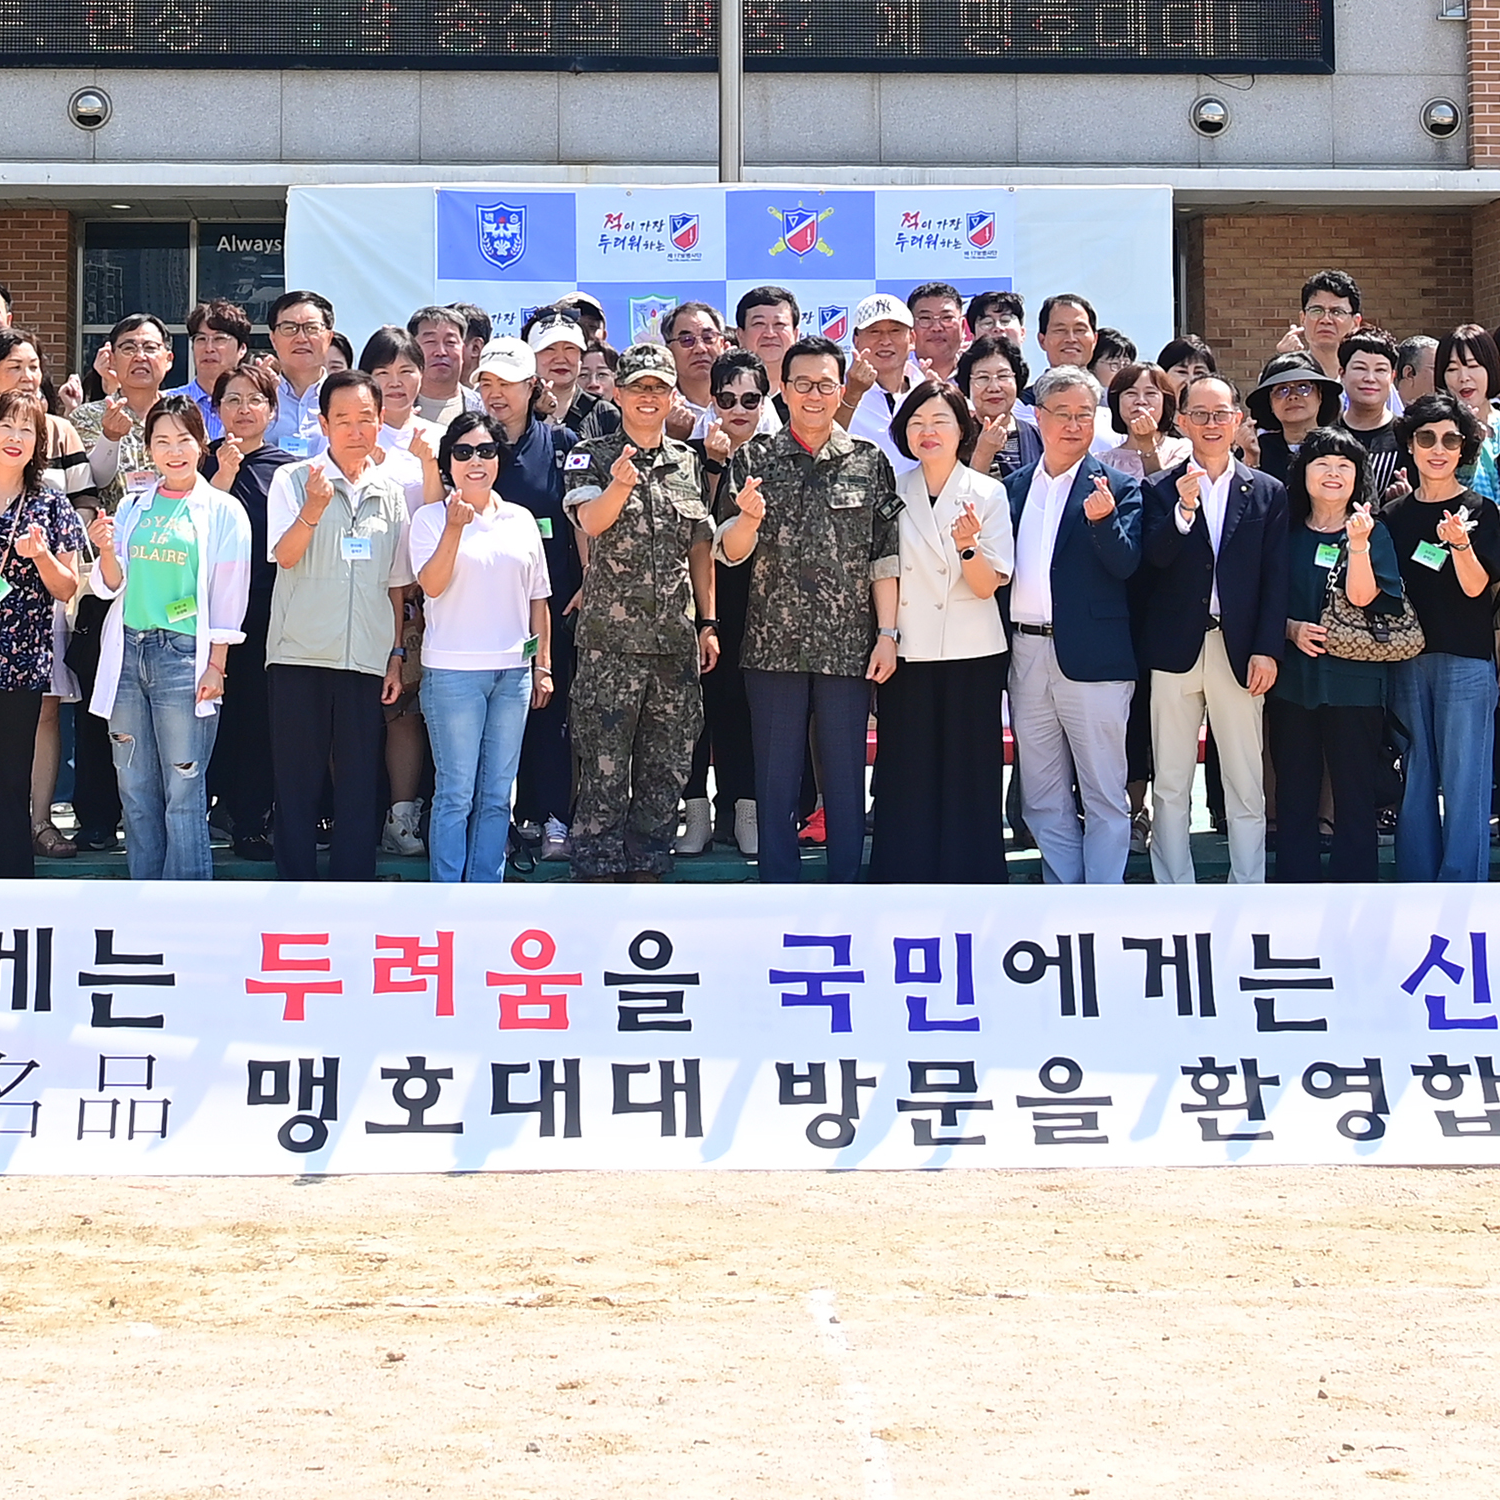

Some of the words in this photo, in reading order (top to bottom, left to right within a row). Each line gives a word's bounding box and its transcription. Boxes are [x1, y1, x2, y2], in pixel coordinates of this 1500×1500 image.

[604, 212, 635, 232] 적이
[640, 219, 666, 233] 가장
[901, 211, 932, 231] 적이
[937, 217, 963, 231] 가장
[216, 234, 282, 252] Always
[801, 311, 815, 325] 장
[130, 545, 188, 566] OLAIRE
[245, 929, 700, 1031] 두려움을
[769, 933, 1334, 1032] 국민에게는
[247, 1056, 704, 1153] 맹호대대
[775, 1056, 1113, 1149] 방문을
